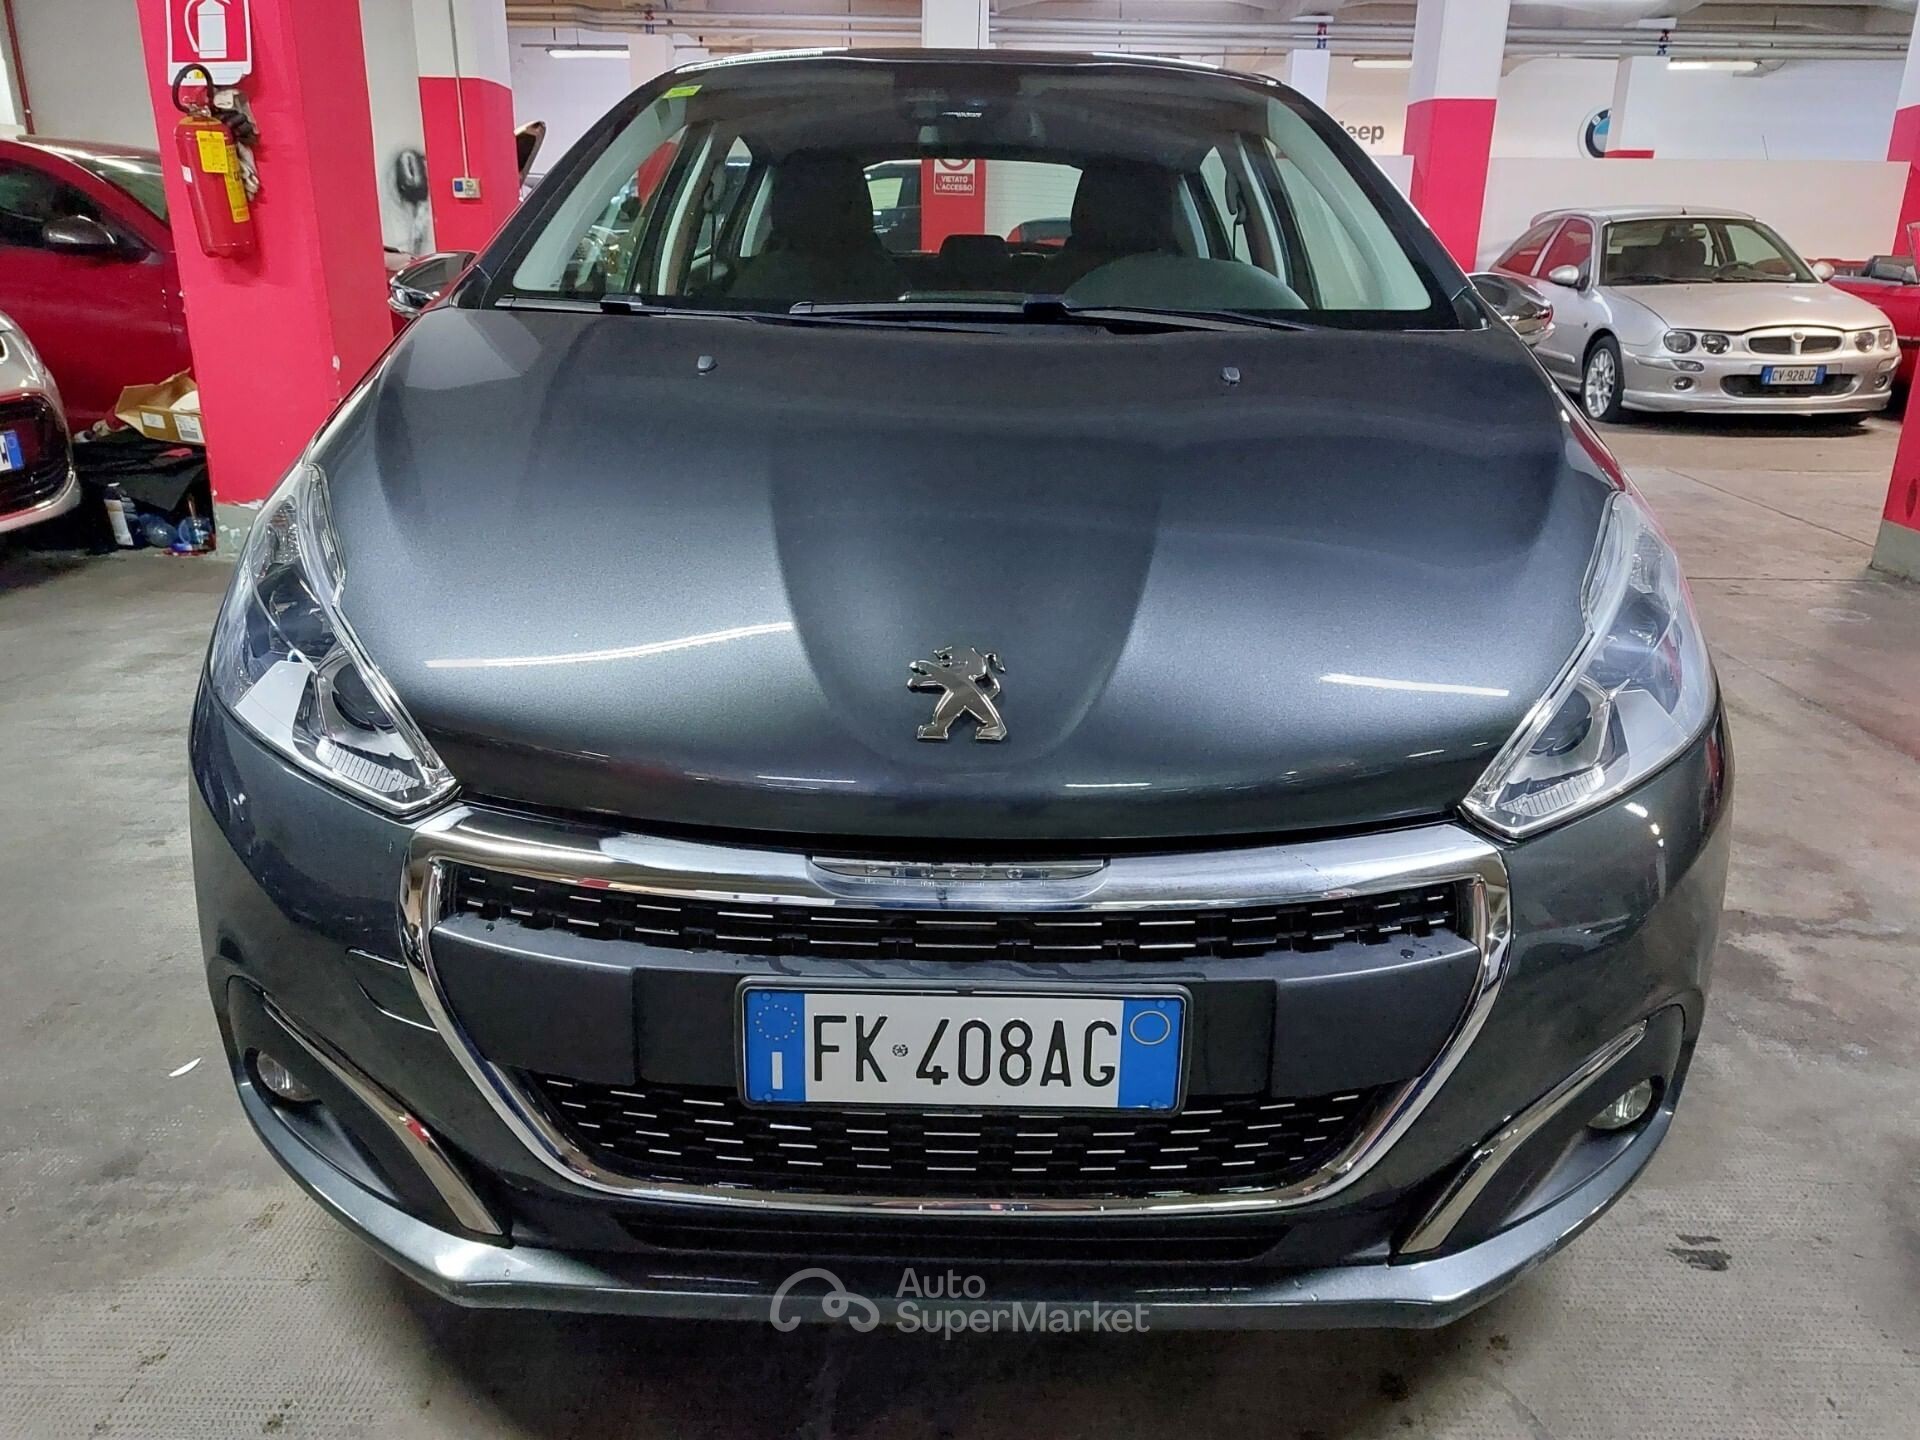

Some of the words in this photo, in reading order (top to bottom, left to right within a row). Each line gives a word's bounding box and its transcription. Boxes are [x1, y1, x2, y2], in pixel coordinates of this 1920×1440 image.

[1338, 120, 1385, 144] eep
[941, 175, 968, 183] VIETATO
[935, 183, 973, 191] L'ACCESSO
